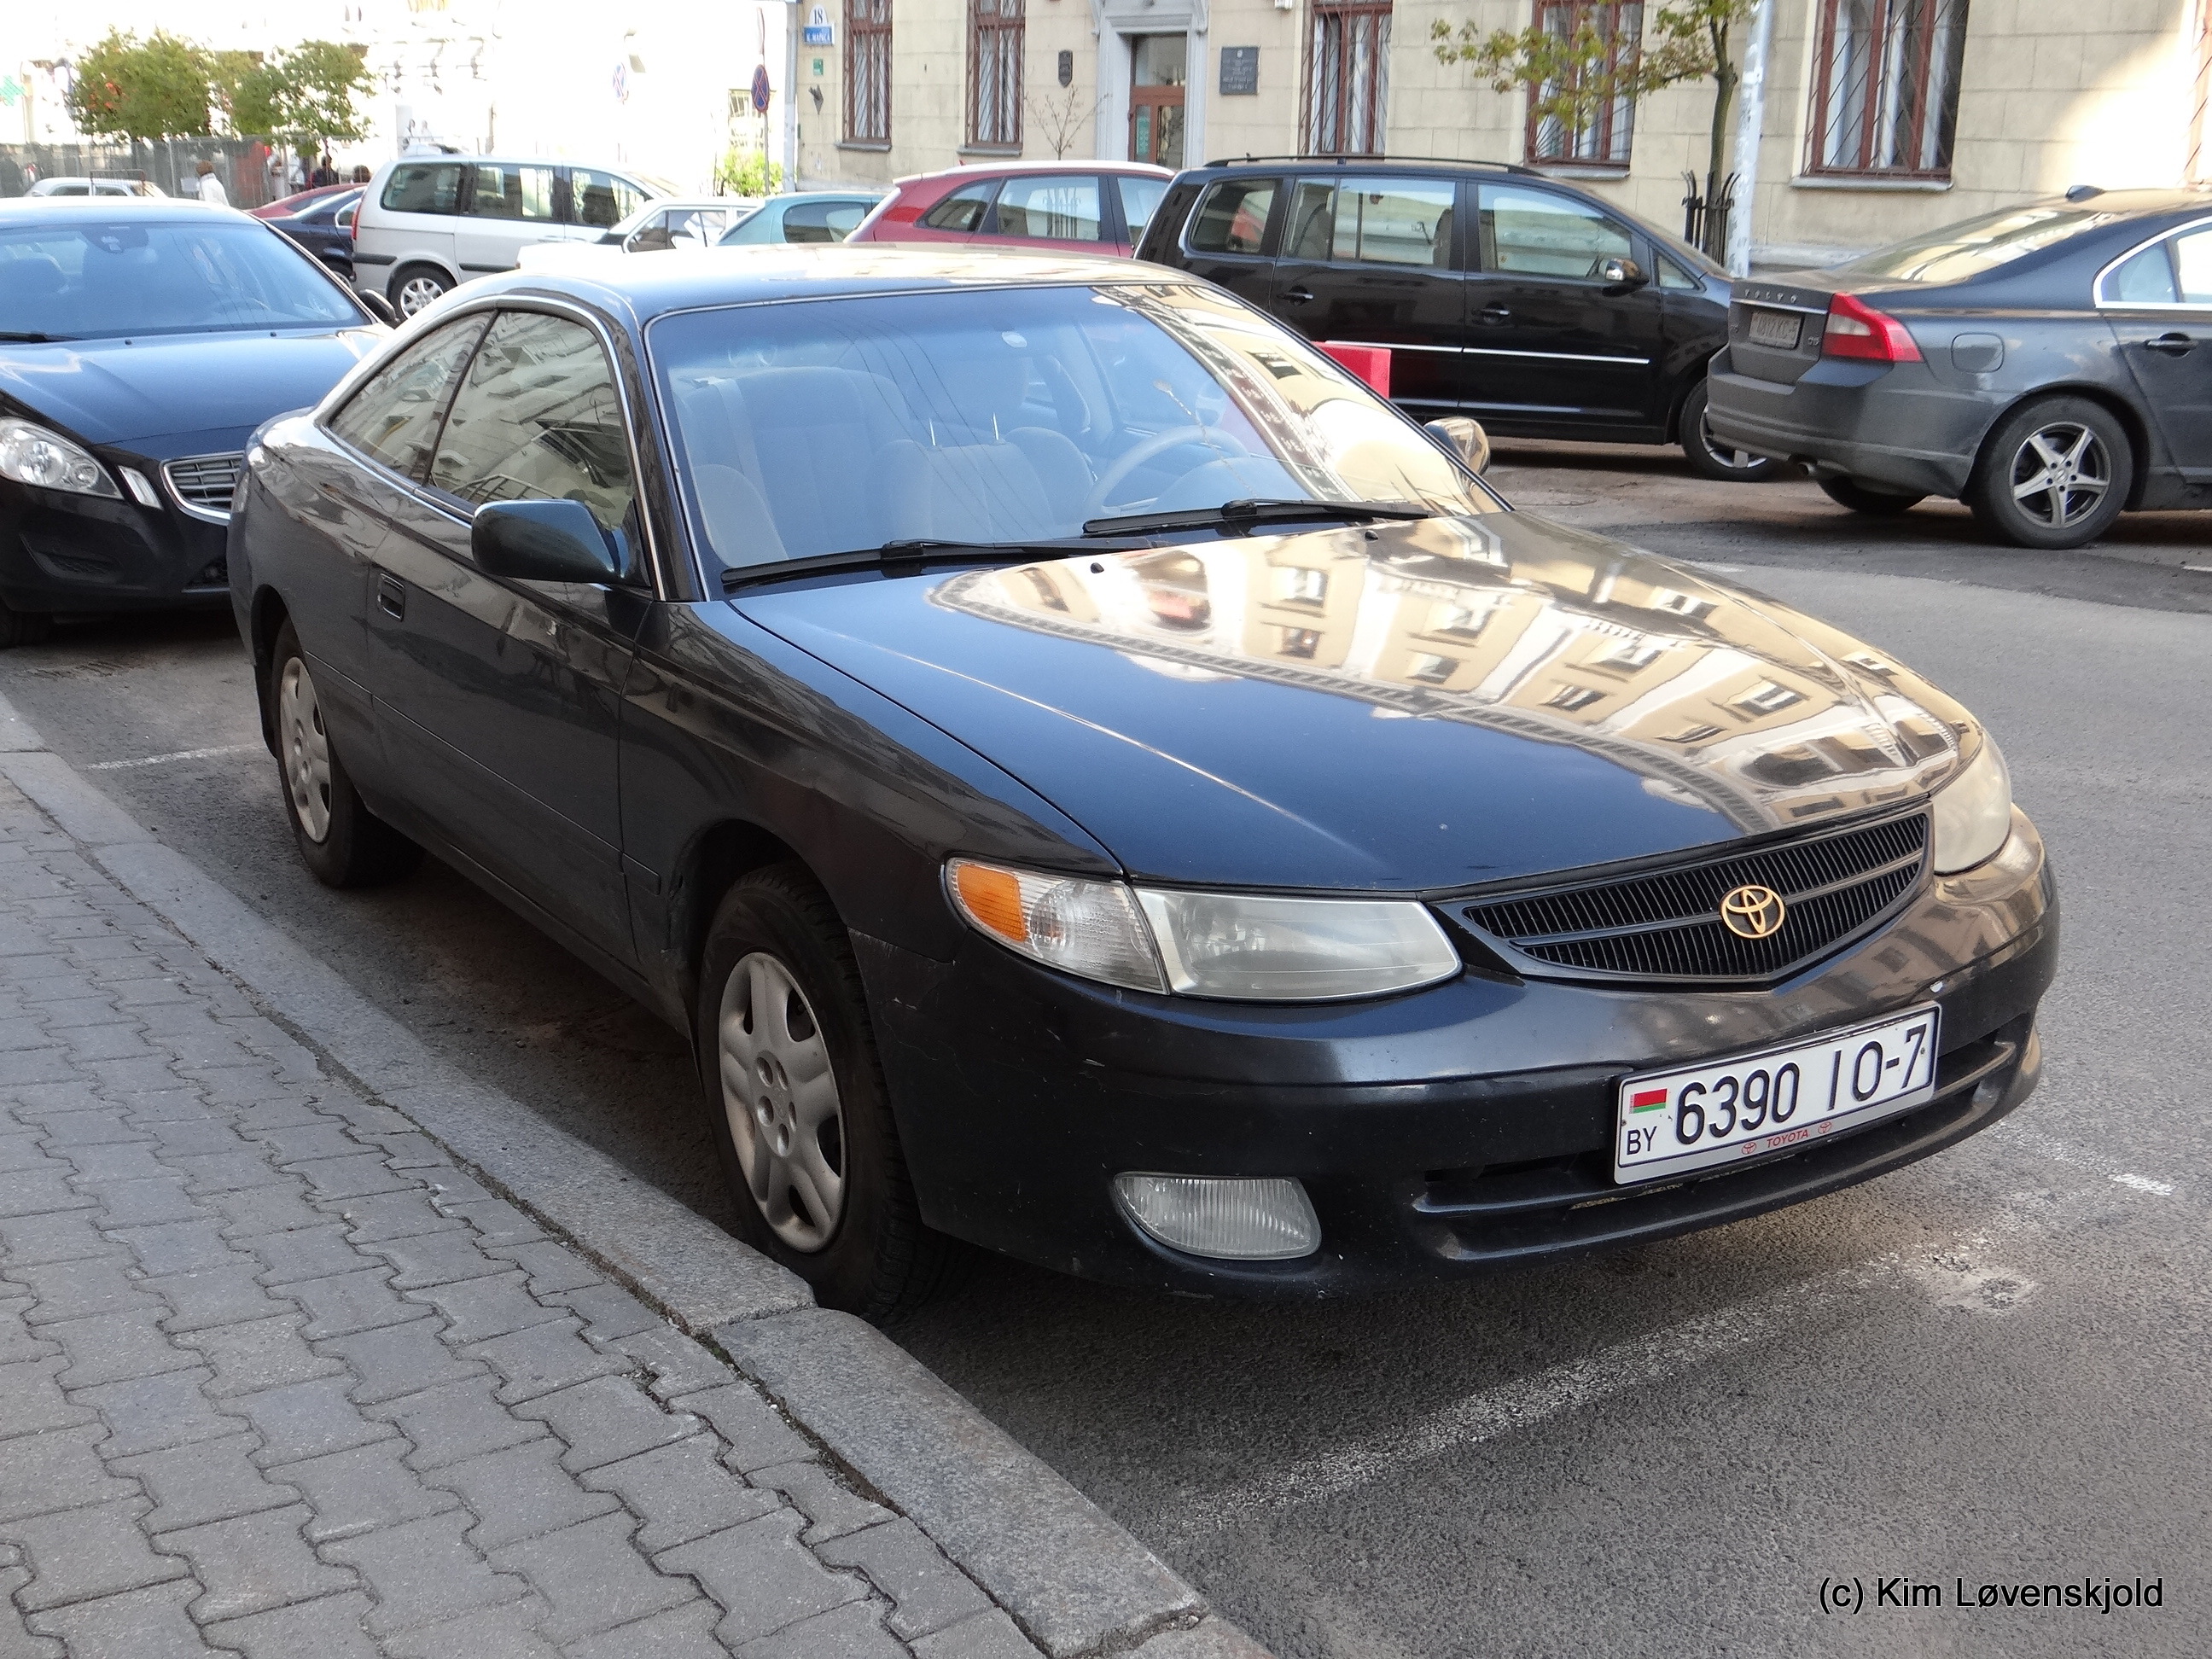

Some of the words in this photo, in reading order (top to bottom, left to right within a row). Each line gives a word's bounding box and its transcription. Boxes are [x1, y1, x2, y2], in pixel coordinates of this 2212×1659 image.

[814, 9, 823, 25] 18
[1744, 288, 1797, 304] VOLVO
[1676, 1062, 1800, 1144] 6390
[1827, 1023, 1927, 1111] IO-7
[1627, 1126, 1657, 1155] BY
[1766, 1129, 1809, 1149] TOYOTA
